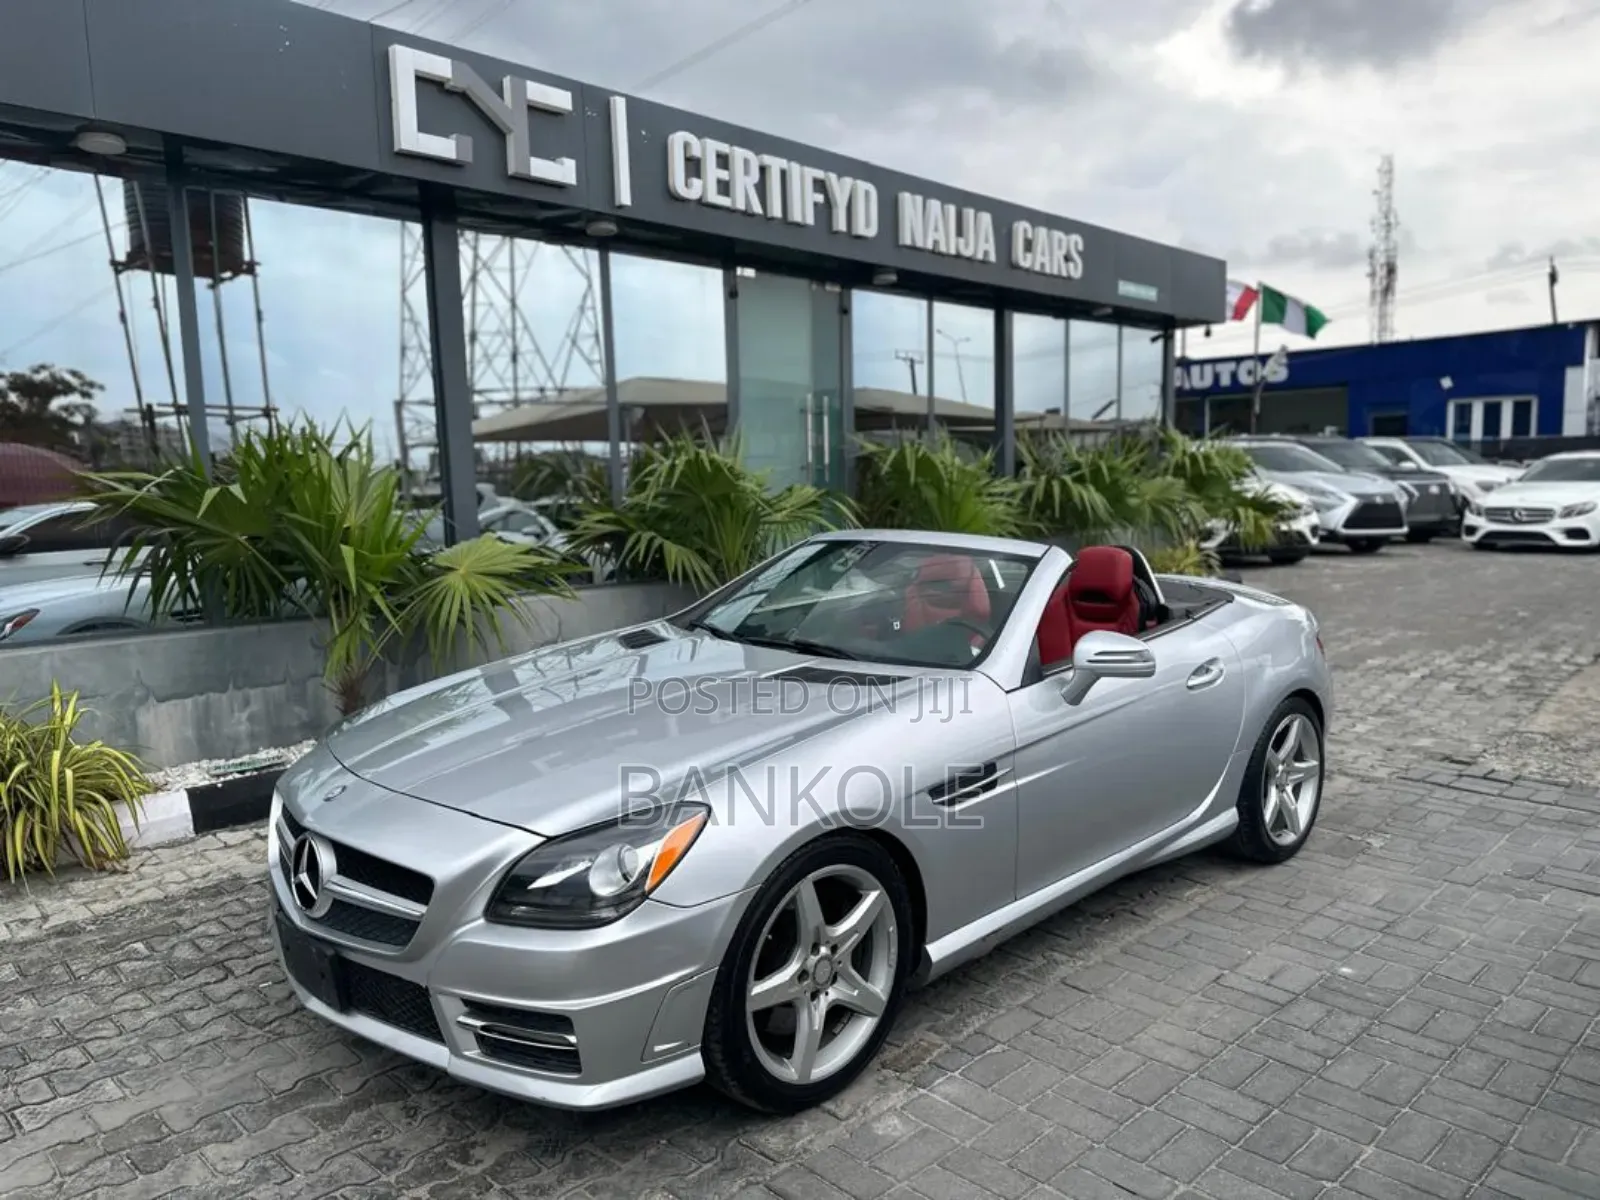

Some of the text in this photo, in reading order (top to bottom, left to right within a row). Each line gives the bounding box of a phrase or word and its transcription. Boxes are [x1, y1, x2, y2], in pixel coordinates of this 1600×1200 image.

[667, 130, 1085, 280] CERTIFYD NAIJA CARS
